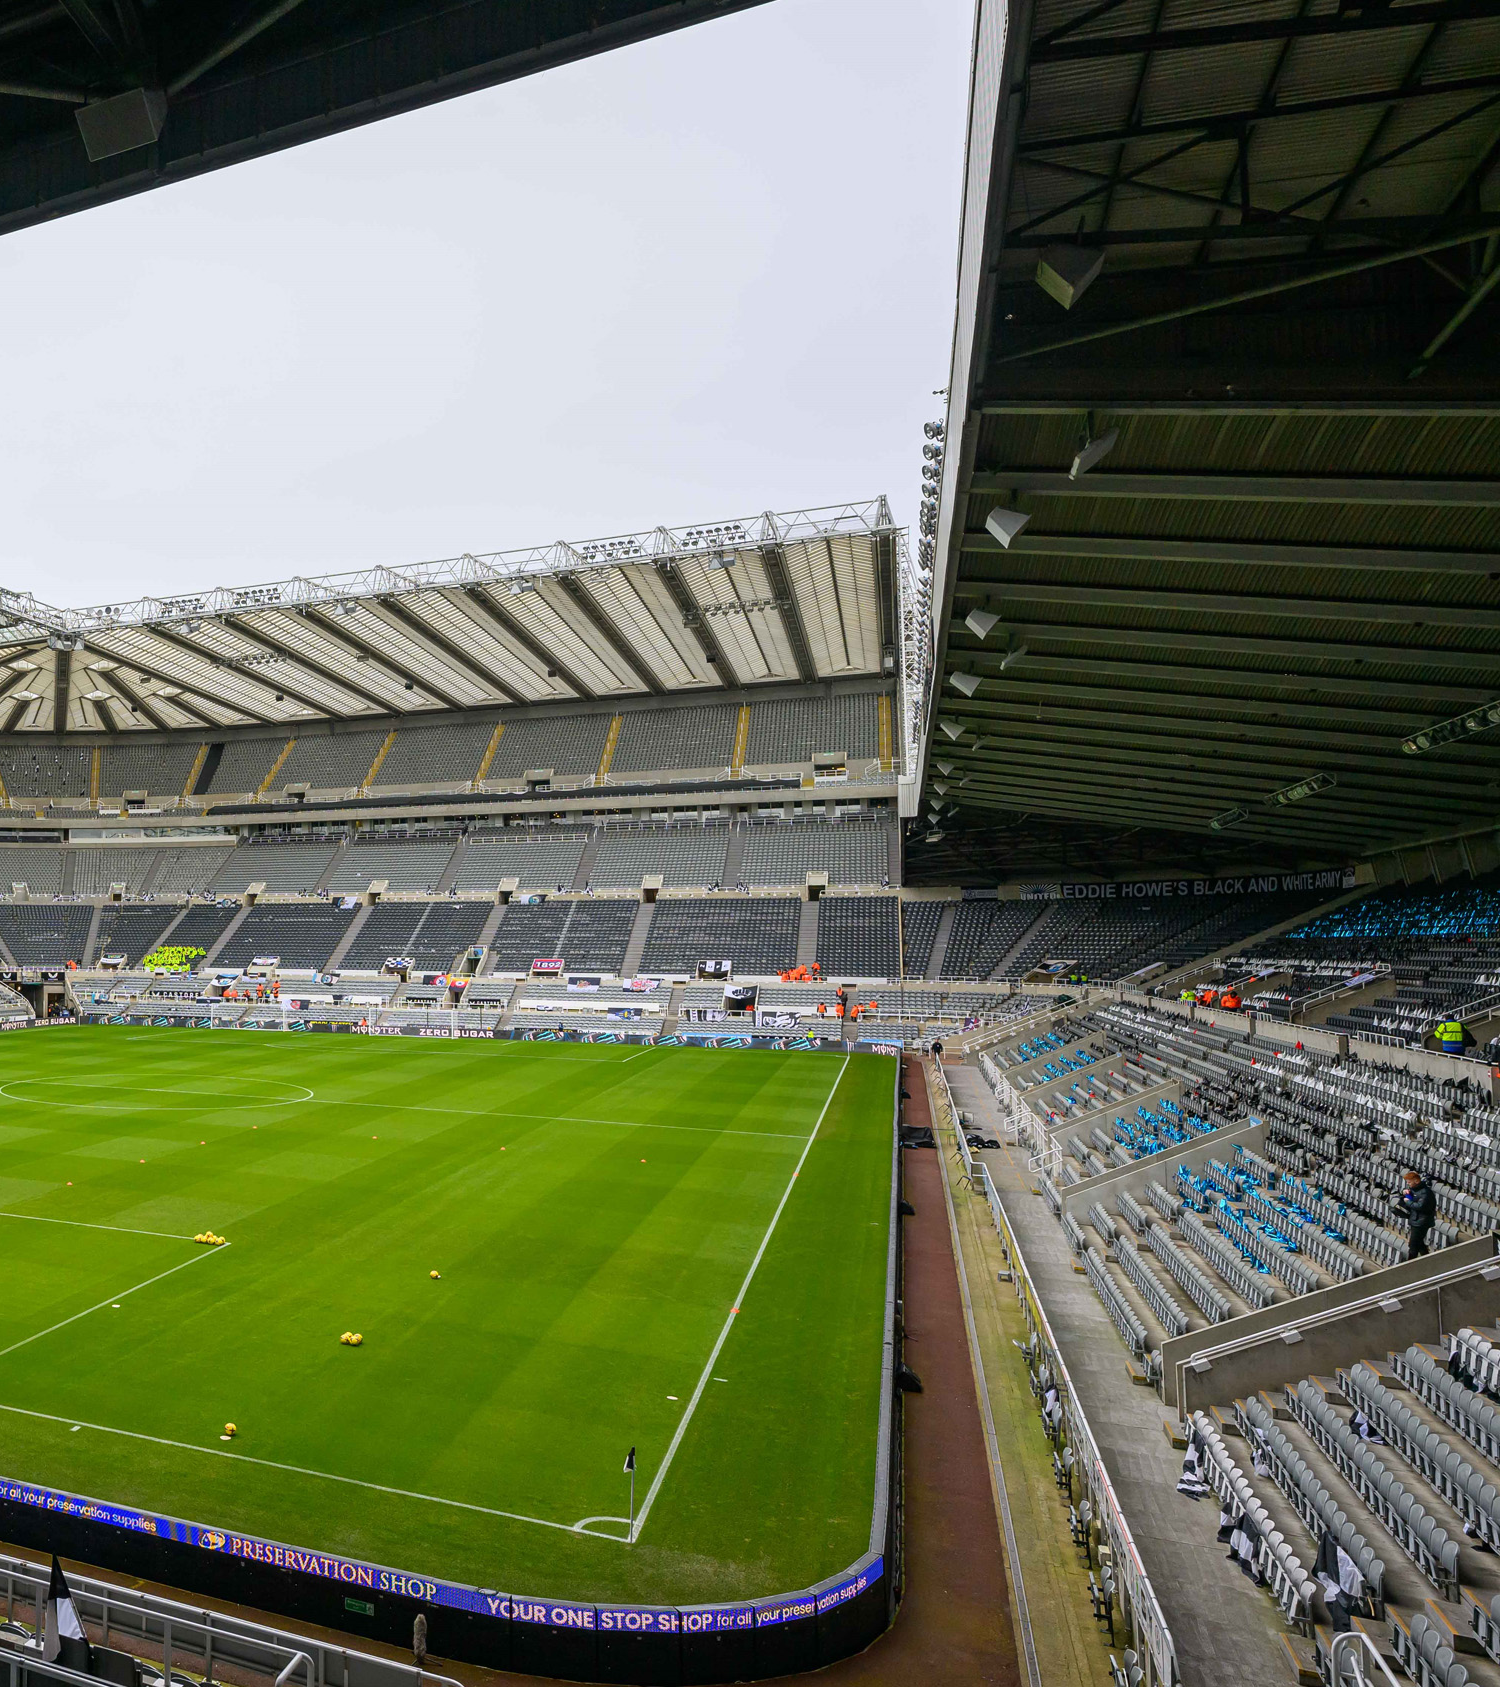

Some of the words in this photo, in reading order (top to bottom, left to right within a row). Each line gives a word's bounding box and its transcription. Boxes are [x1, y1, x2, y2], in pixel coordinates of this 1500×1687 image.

[1063, 884, 1116, 898] EDDIE
[1122, 882, 1188, 898] HOWE'S
[1194, 878, 1244, 895] BLACK
[1248, 876, 1278, 892] AND
[1282, 873, 1313, 891] WHITE
[1315, 870, 1341, 889] ARMY
[536, 961, 561, 969] 1892
[51, 1018, 76, 1026] SUGAR
[420, 1028, 449, 1037] ZERO
[454, 1030, 494, 1038] SUGAR
[9, 1486, 21, 1499] all
[23, 1490, 45, 1506] your
[47, 1495, 111, 1522] preservation
[112, 1512, 157, 1533] supplies
[232, 1537, 373, 1587] PRESERVATION
[379, 1572, 437, 1600] SHOP
[487, 1597, 547, 1624] YOUR
[551, 1608, 594, 1629] ONE
[601, 1612, 653, 1630] STOP
[658, 1613, 714, 1632] SHOP
[717, 1614, 733, 1627] for
[736, 1612, 752, 1625] all
[756, 1611, 780, 1627] your
[782, 1591, 840, 1621] preservation
